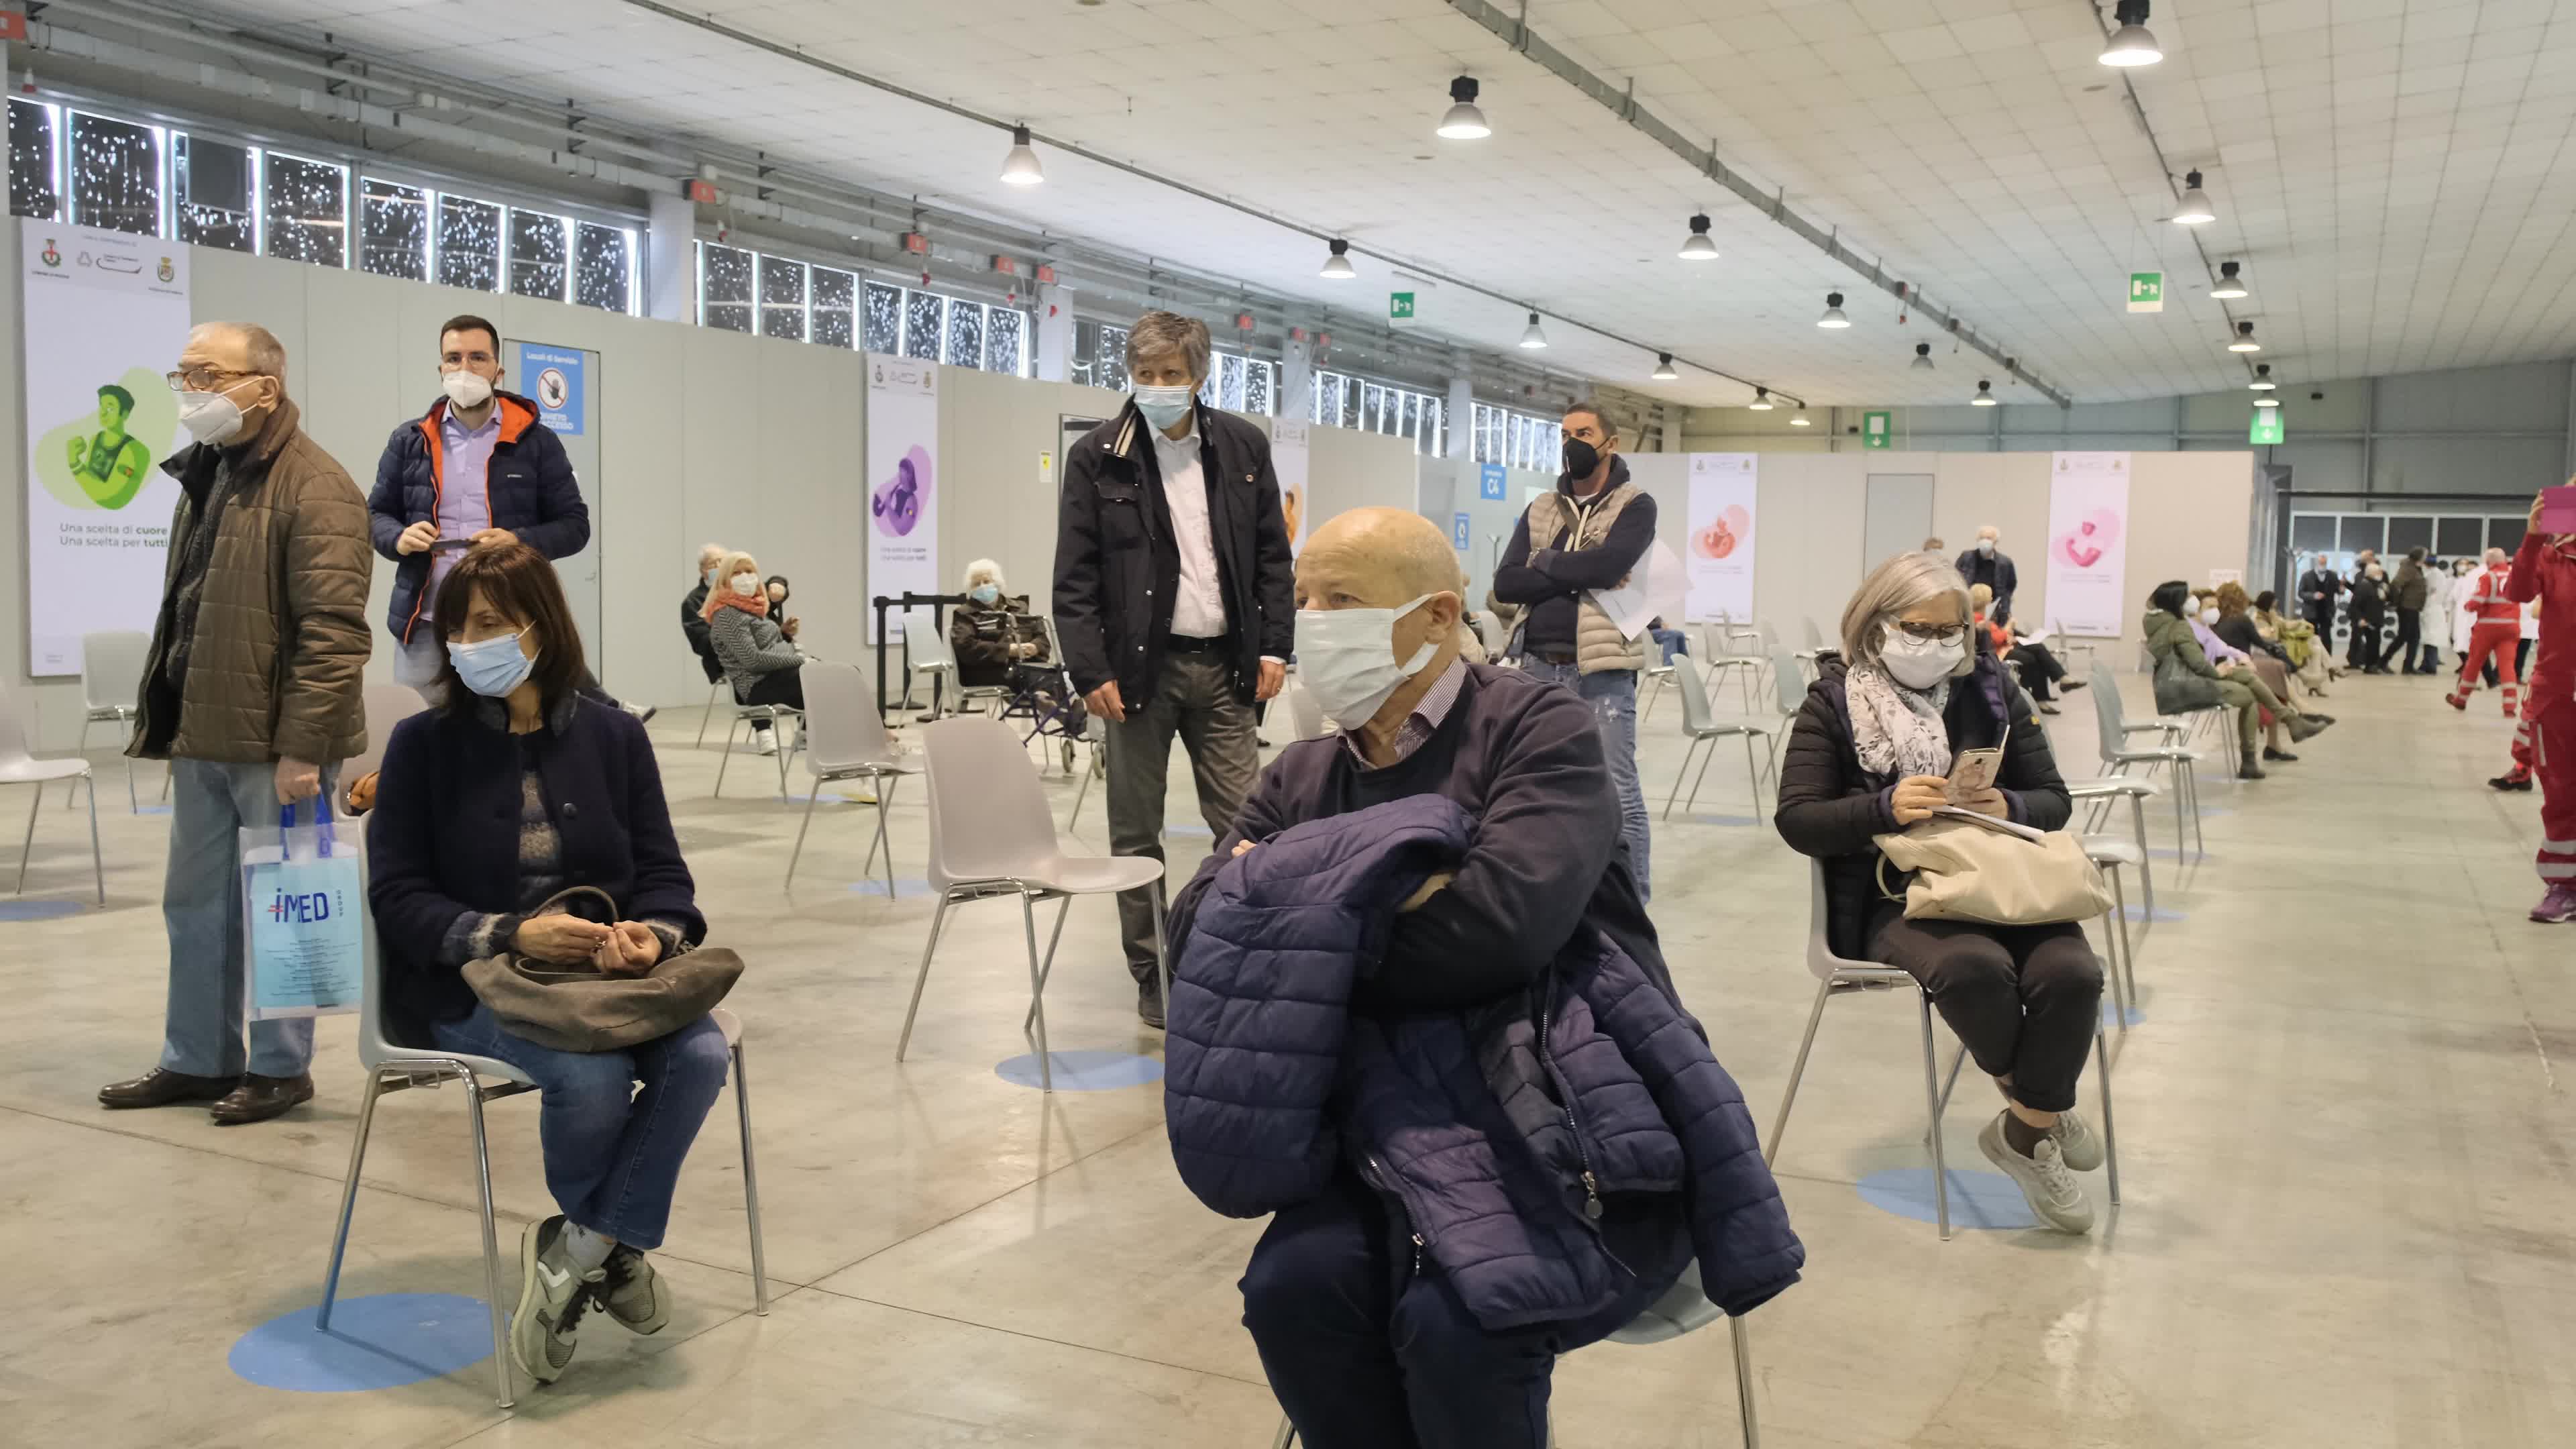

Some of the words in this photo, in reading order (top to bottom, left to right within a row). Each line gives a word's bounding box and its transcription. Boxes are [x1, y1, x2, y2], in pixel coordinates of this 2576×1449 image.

[60, 523, 83, 532] Una
[86, 524, 119, 534] scelta
[122, 525, 133, 535] di
[136, 527, 168, 535] cuore
[60, 536, 83, 546] Una
[86, 537, 119, 547] scelta
[122, 539, 140, 551] per
[144, 538, 168, 547] tutti
